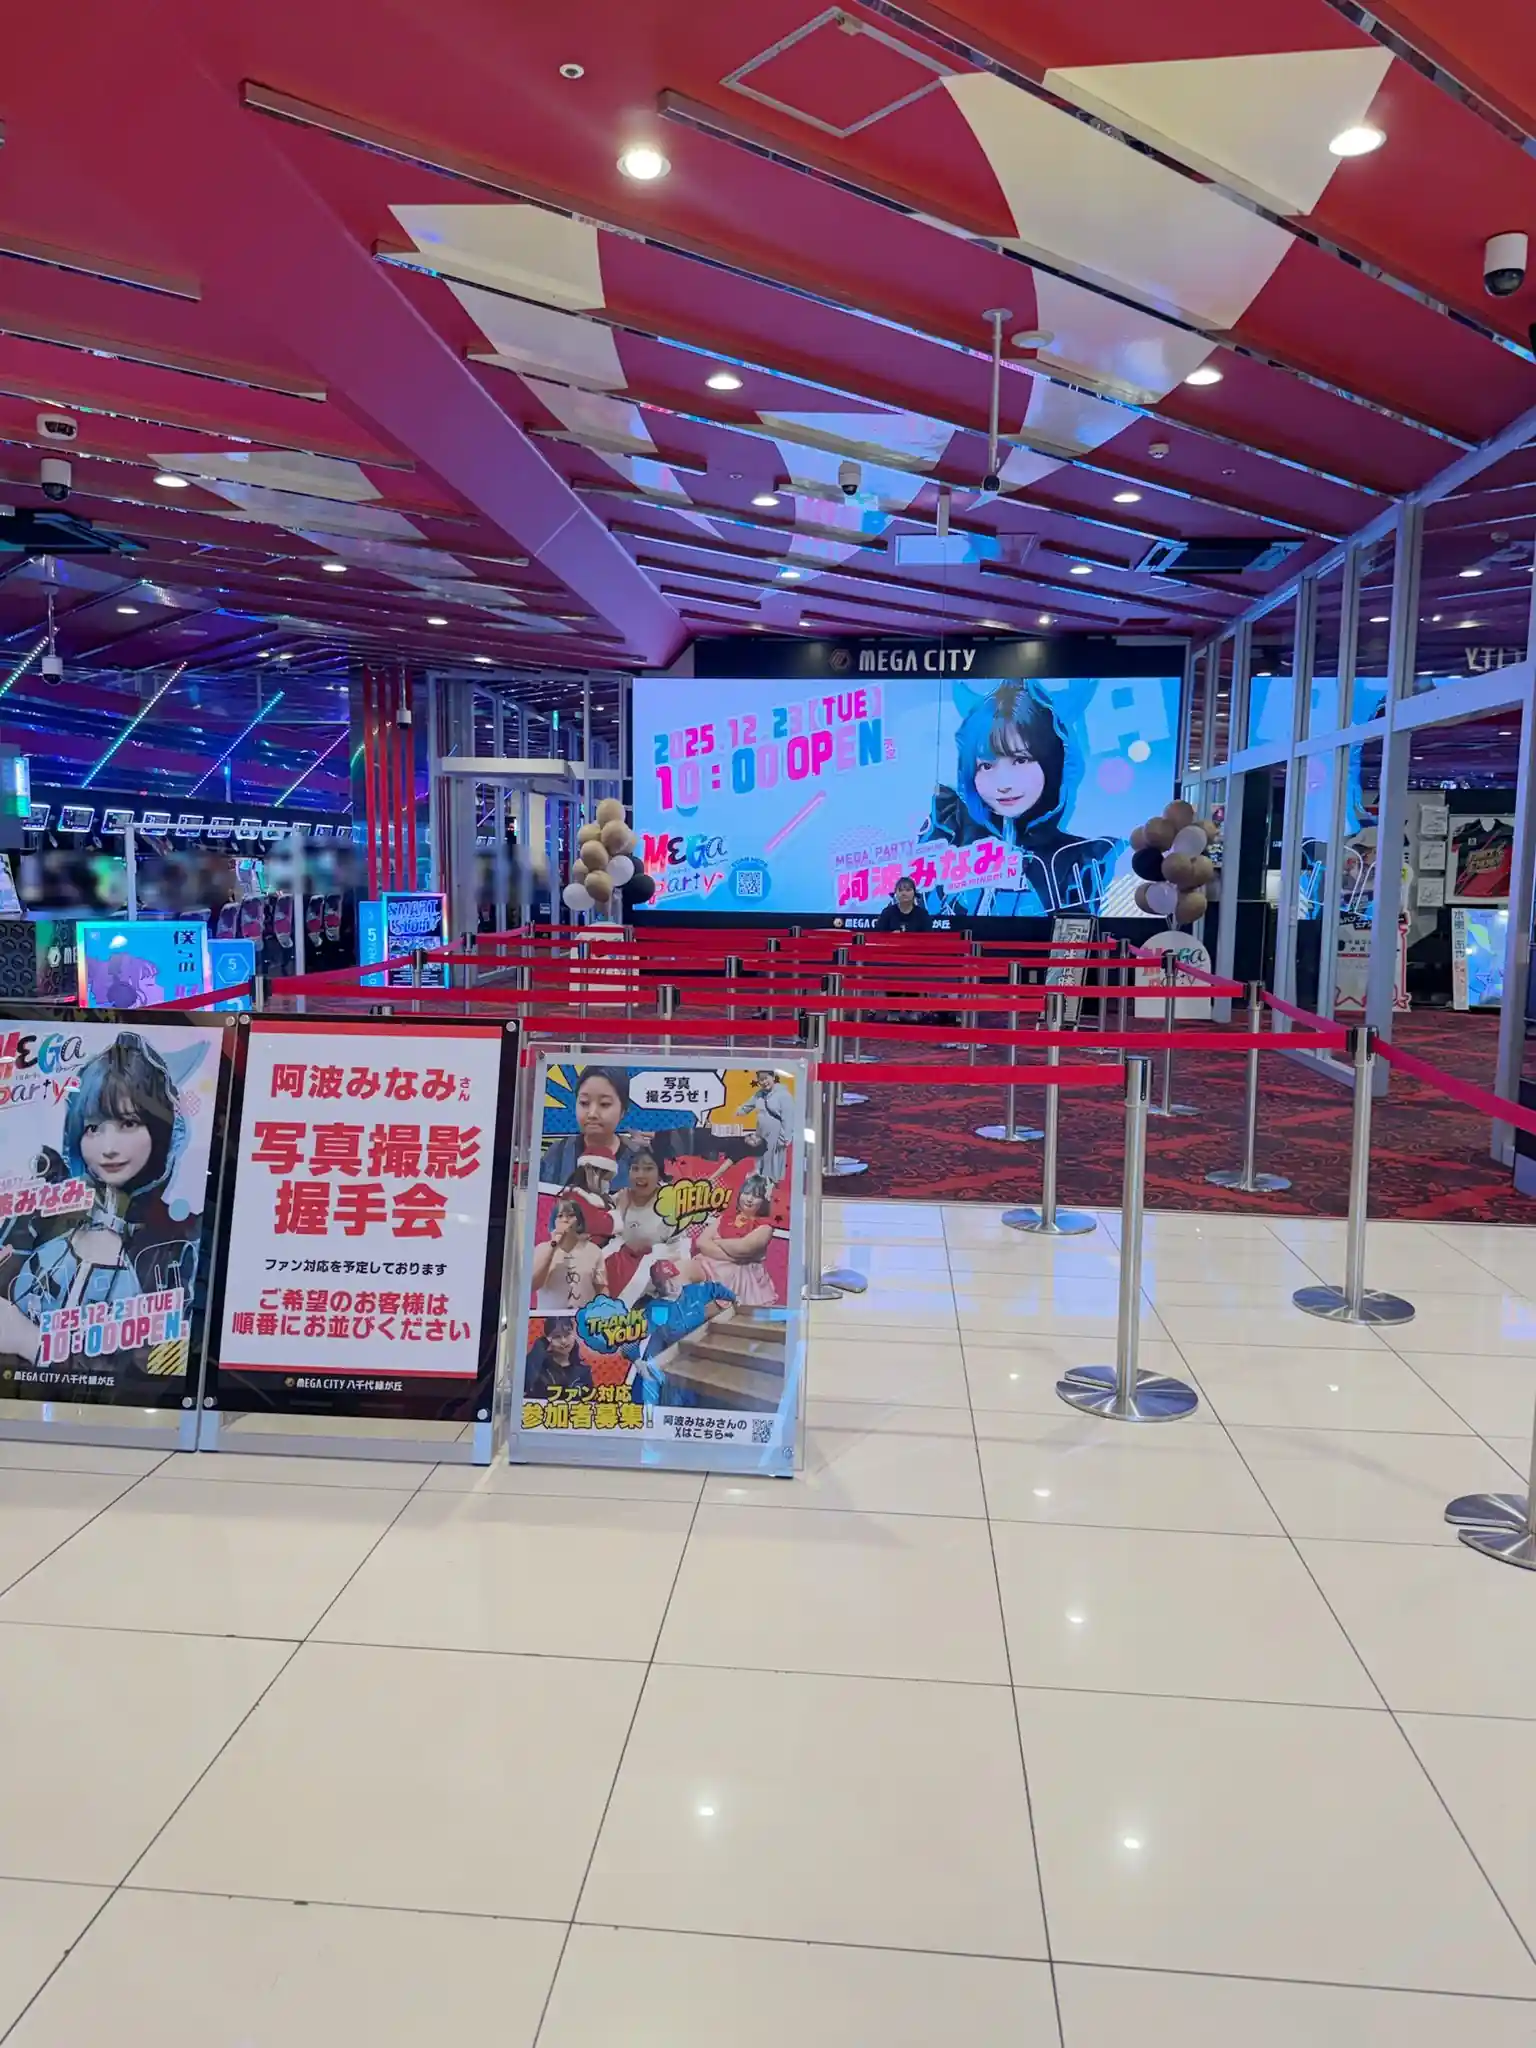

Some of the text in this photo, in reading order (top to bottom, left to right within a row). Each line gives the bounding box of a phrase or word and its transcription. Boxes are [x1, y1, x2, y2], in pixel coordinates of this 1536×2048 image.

[859, 649, 977, 672] MEGA CITY
[787, 718, 882, 780] OPEN
[875, 839, 915, 860] PARTY
[646, 1090, 708, 1103] 撮ろうぜ！
[664, 1077, 690, 1090] 写真
[251, 1122, 482, 1179] 写真撮影
[274, 1180, 448, 1239] 握手会
[676, 1186, 733, 1219] HELLO!
[264, 1259, 448, 1276] ファン対応を予定しております
[259, 1289, 450, 1316] ご希望のお客様は
[232, 1312, 471, 1341] 順番にお並びください
[586, 1308, 646, 1336] THANK
[603, 1319, 648, 1347] YOU!
[41, 1312, 181, 1362] 10:00 OPEN
[14, 1371, 38, 1381] MEGA
[39, 1372, 61, 1382] CITY
[296, 1377, 322, 1389] MEGA
[323, 1378, 346, 1390] CITY
[547, 1385, 632, 1402] ファン対応
[521, 1403, 654, 1430] 参加者募集！
[663, 1415, 748, 1429] 阿波みなみさんの
